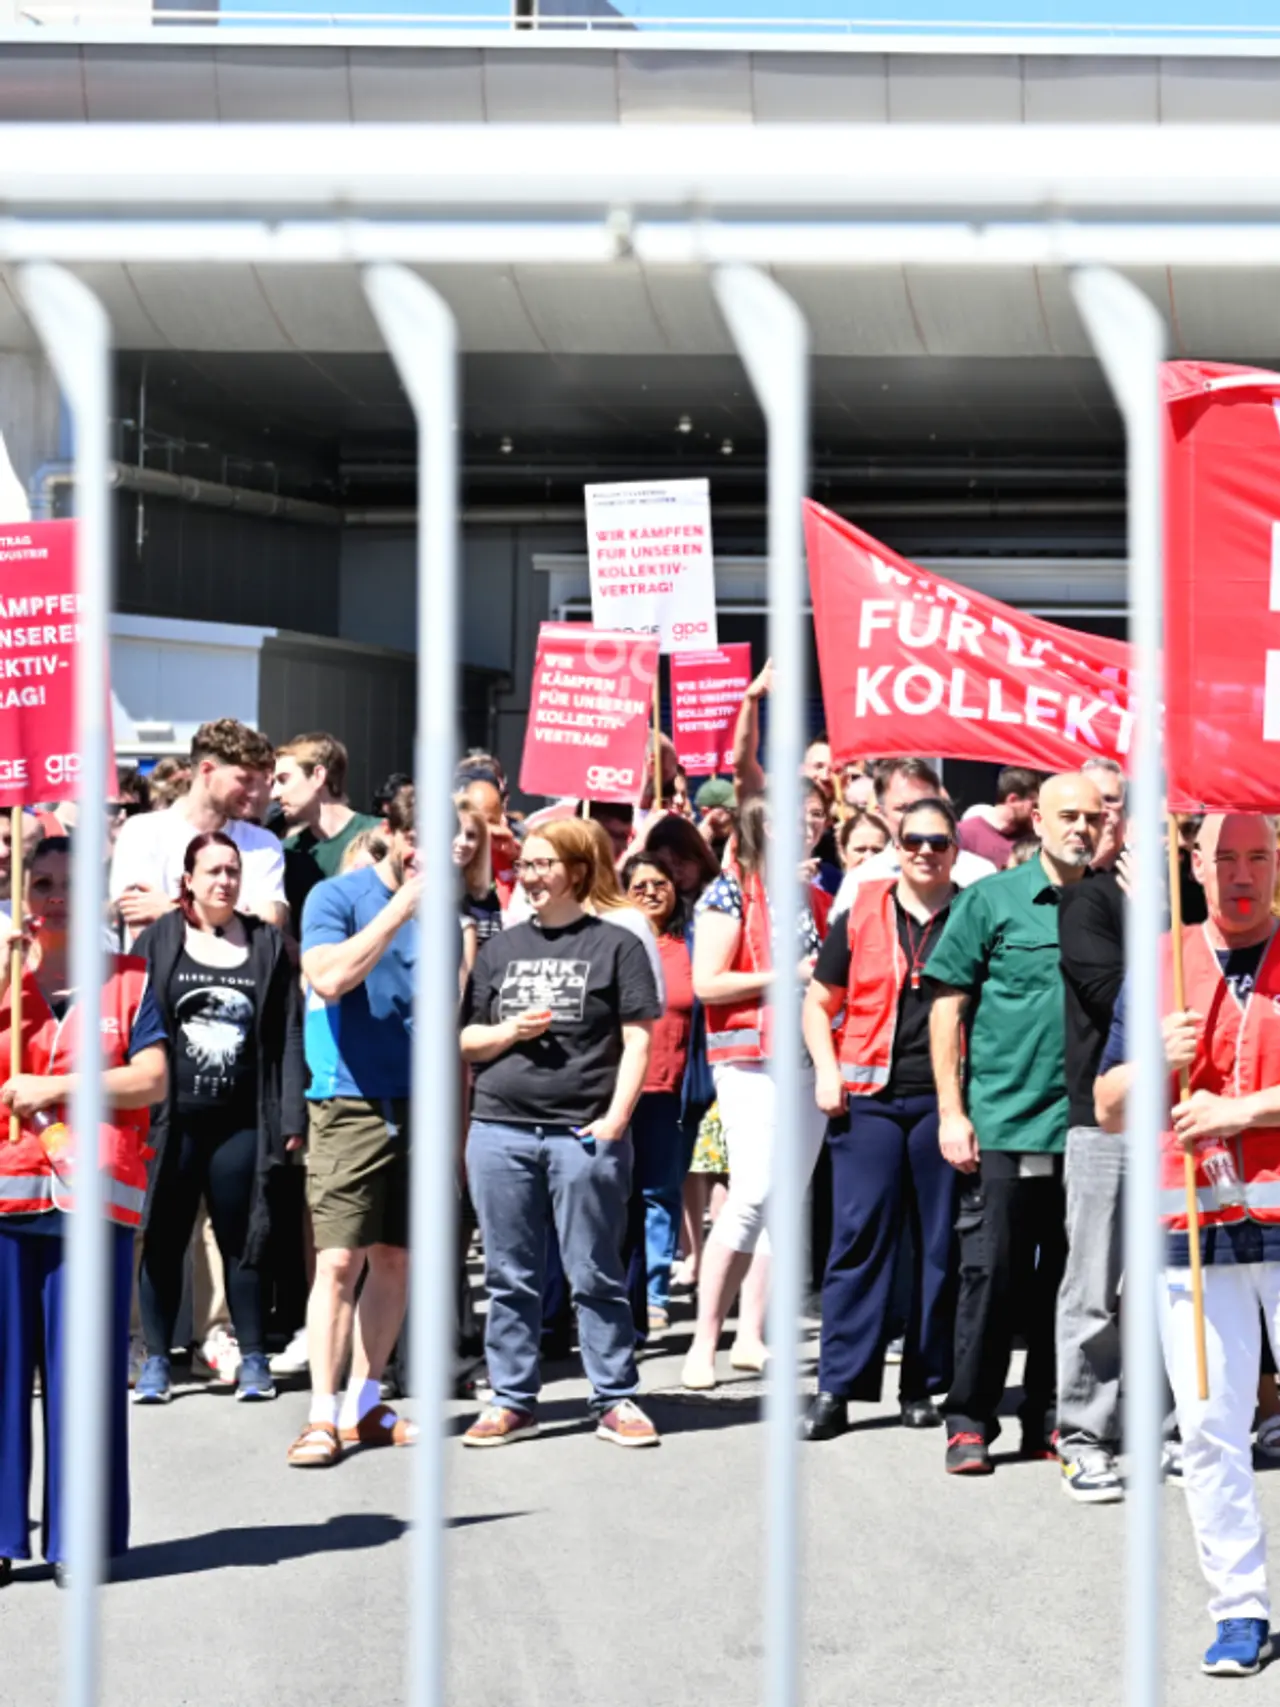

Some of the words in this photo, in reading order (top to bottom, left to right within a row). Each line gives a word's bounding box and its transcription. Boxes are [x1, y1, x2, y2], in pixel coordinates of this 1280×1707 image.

[672, 621, 709, 642] gpa
[858, 591, 986, 658] FÜR
[44, 752, 84, 786] gp
[585, 765, 635, 790] gpa
